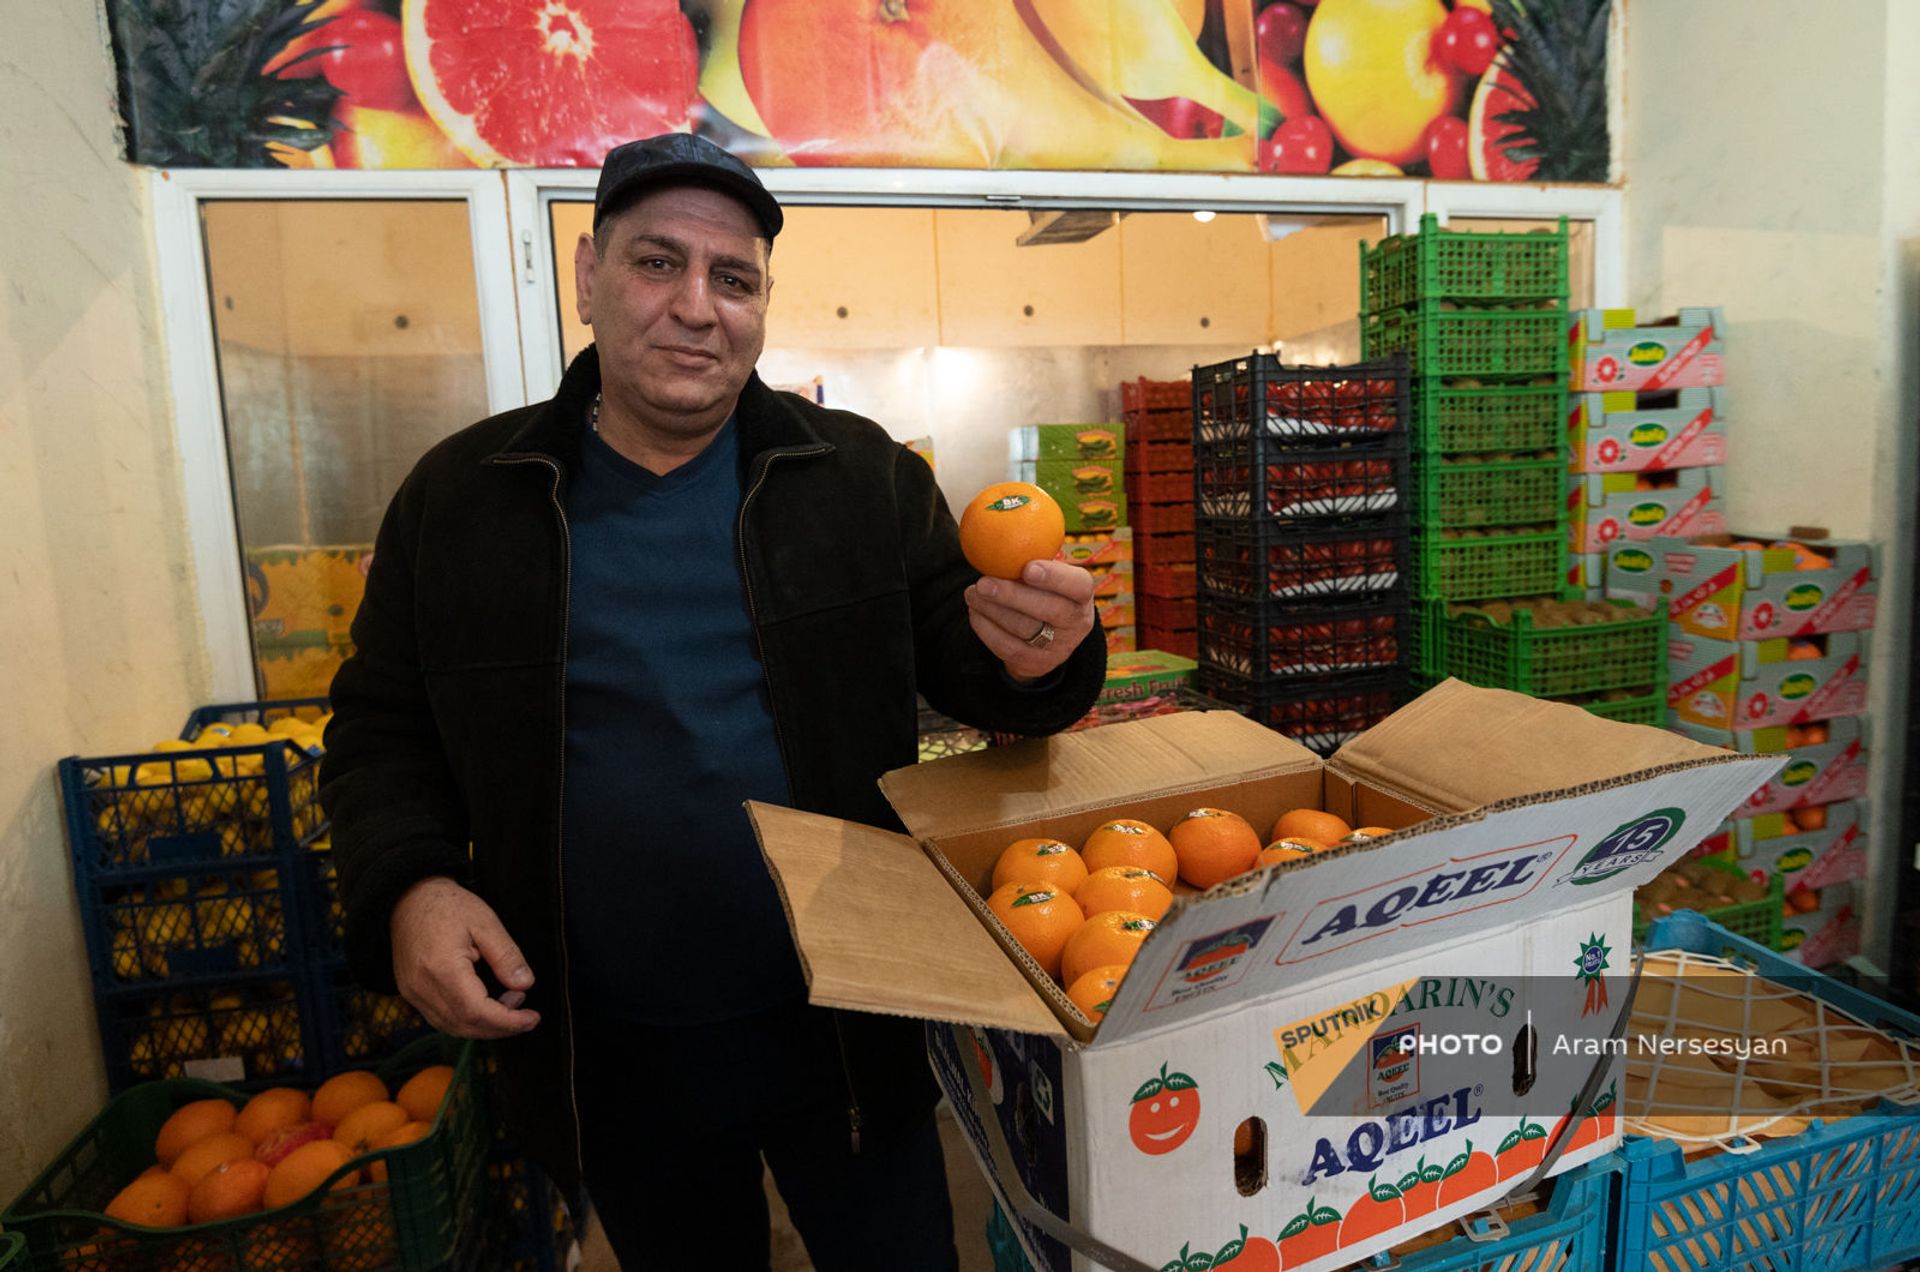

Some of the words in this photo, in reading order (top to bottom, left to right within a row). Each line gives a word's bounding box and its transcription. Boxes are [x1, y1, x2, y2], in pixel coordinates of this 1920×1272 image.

[1582, 854, 1643, 874] YEARS
[1611, 823, 1664, 854] 15
[1302, 853, 1540, 945] AQEEL
[1302, 1087, 1482, 1187] AQEEL
